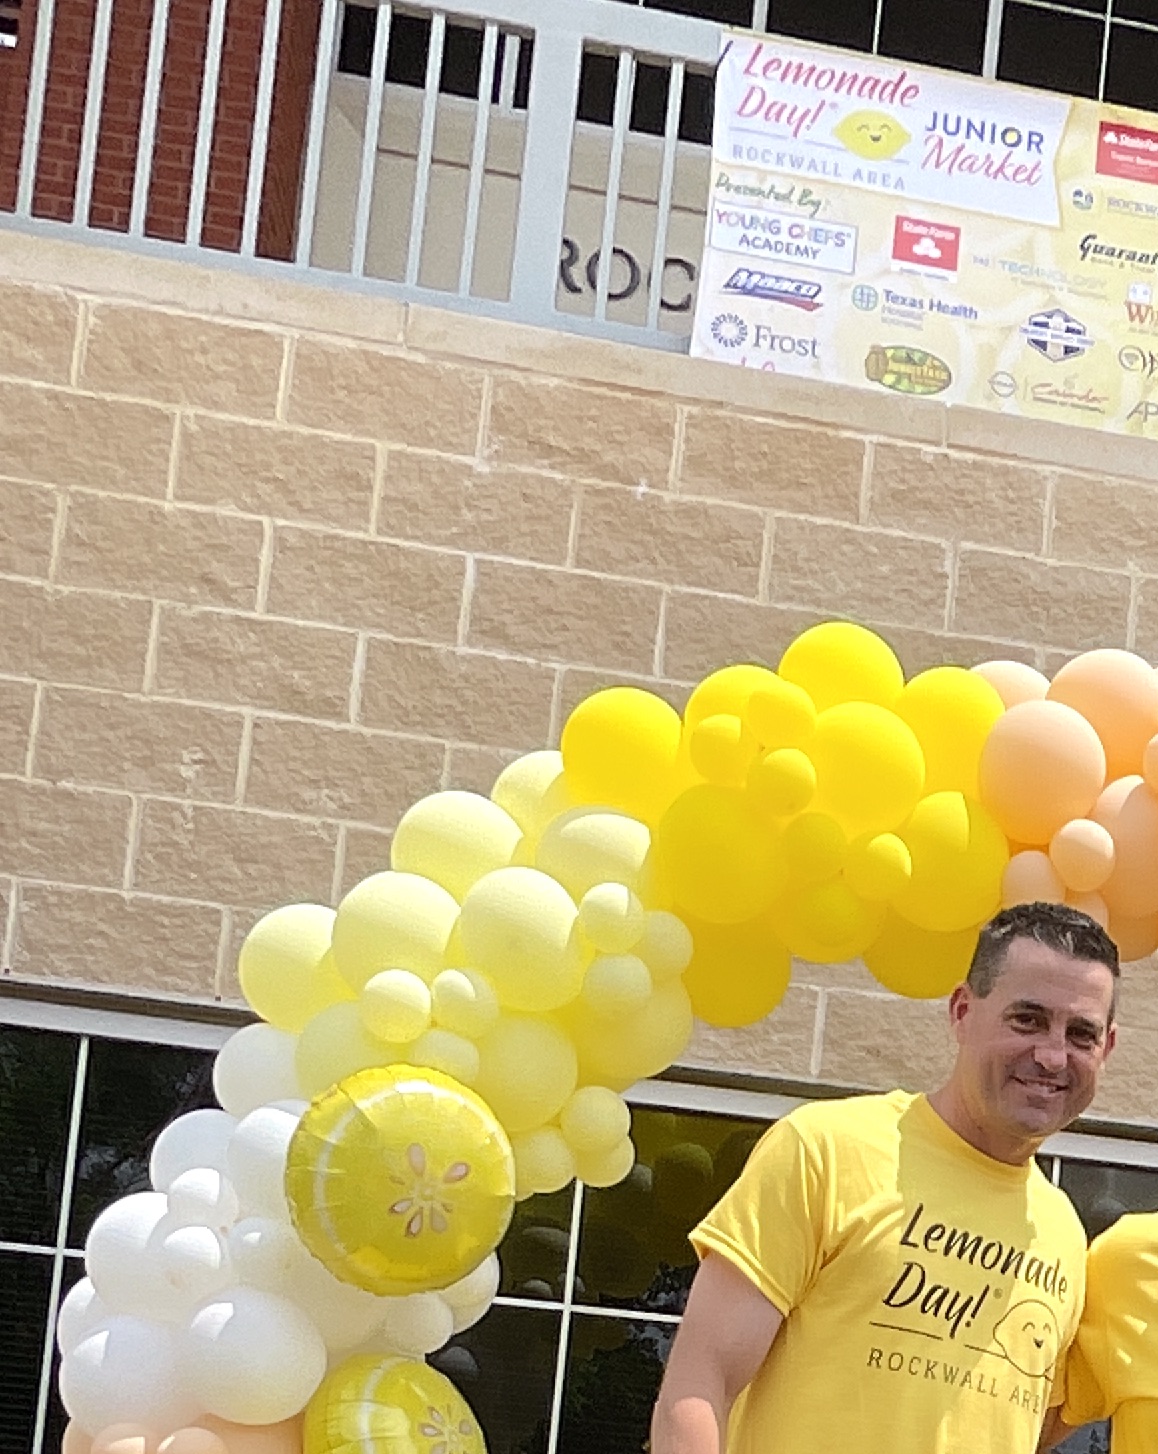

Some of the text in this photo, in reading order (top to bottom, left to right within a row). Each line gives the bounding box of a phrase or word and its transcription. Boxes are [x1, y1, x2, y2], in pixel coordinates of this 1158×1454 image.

[743, 43, 919, 107] Lemonade
[925, 111, 1044, 154] JUNIOR
[732, 144, 905, 190] ROCKWALL AREA
[921, 134, 1043, 186] Market
[715, 208, 782, 235] YOUNG
[738, 233, 821, 260] ACADEMY
[883, 288, 924, 310] Texas
[928, 298, 978, 320] Health
[753, 324, 819, 359] Frost
[900, 1203, 1067, 1303] Lemonade
[867, 1347, 998, 1398] ROCKWALL
